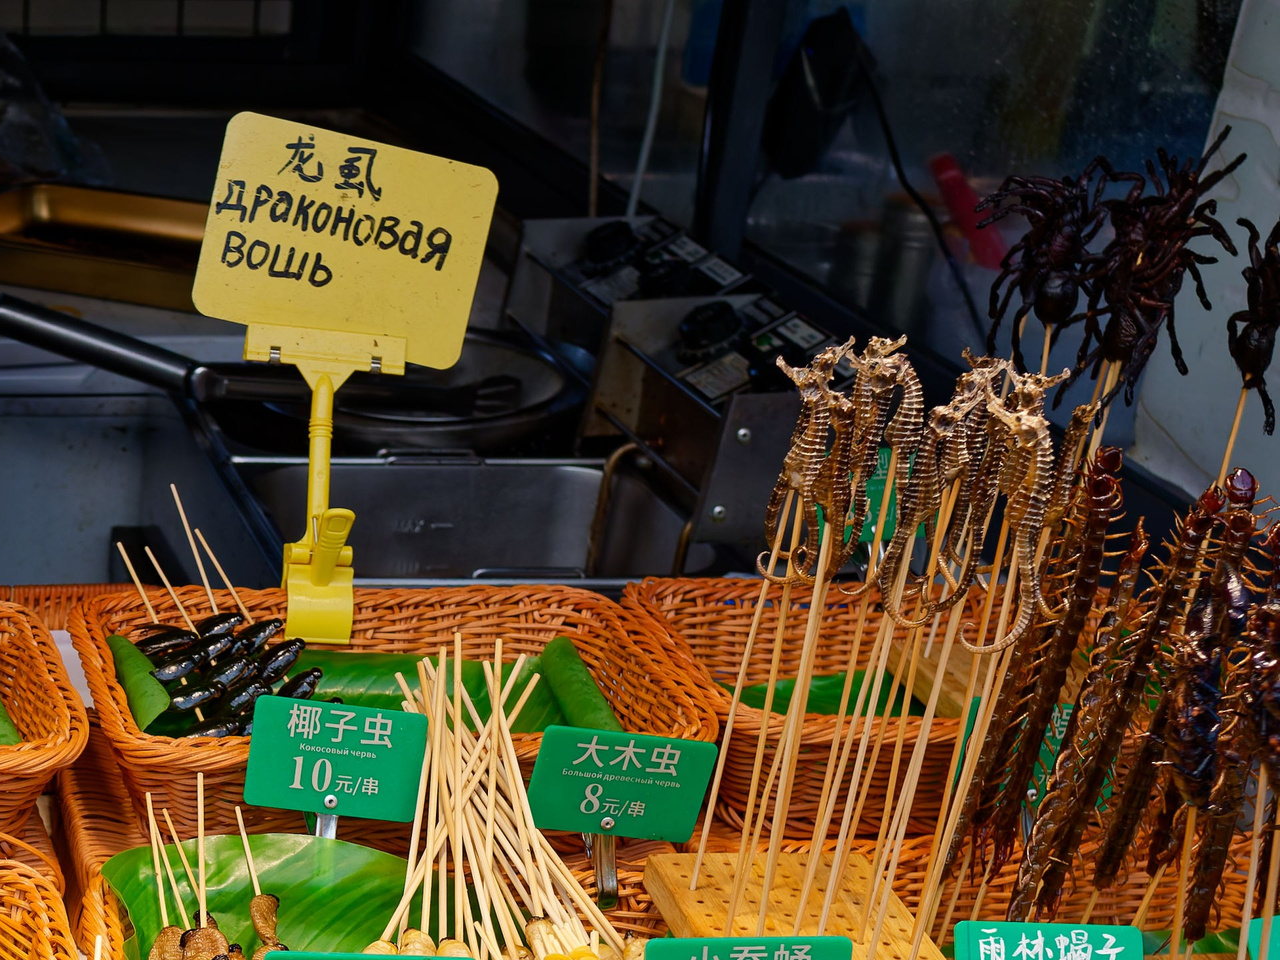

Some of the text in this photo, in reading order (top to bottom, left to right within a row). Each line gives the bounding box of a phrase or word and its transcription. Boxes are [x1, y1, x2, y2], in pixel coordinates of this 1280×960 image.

[277, 134, 382, 202] 龙虱
[287, 703, 392, 749] 椰子虫
[299, 743, 377, 759] Кокосовый червь
[572, 735, 681, 776] 大木虫
[562, 768, 681, 788] Большой древесный червь
